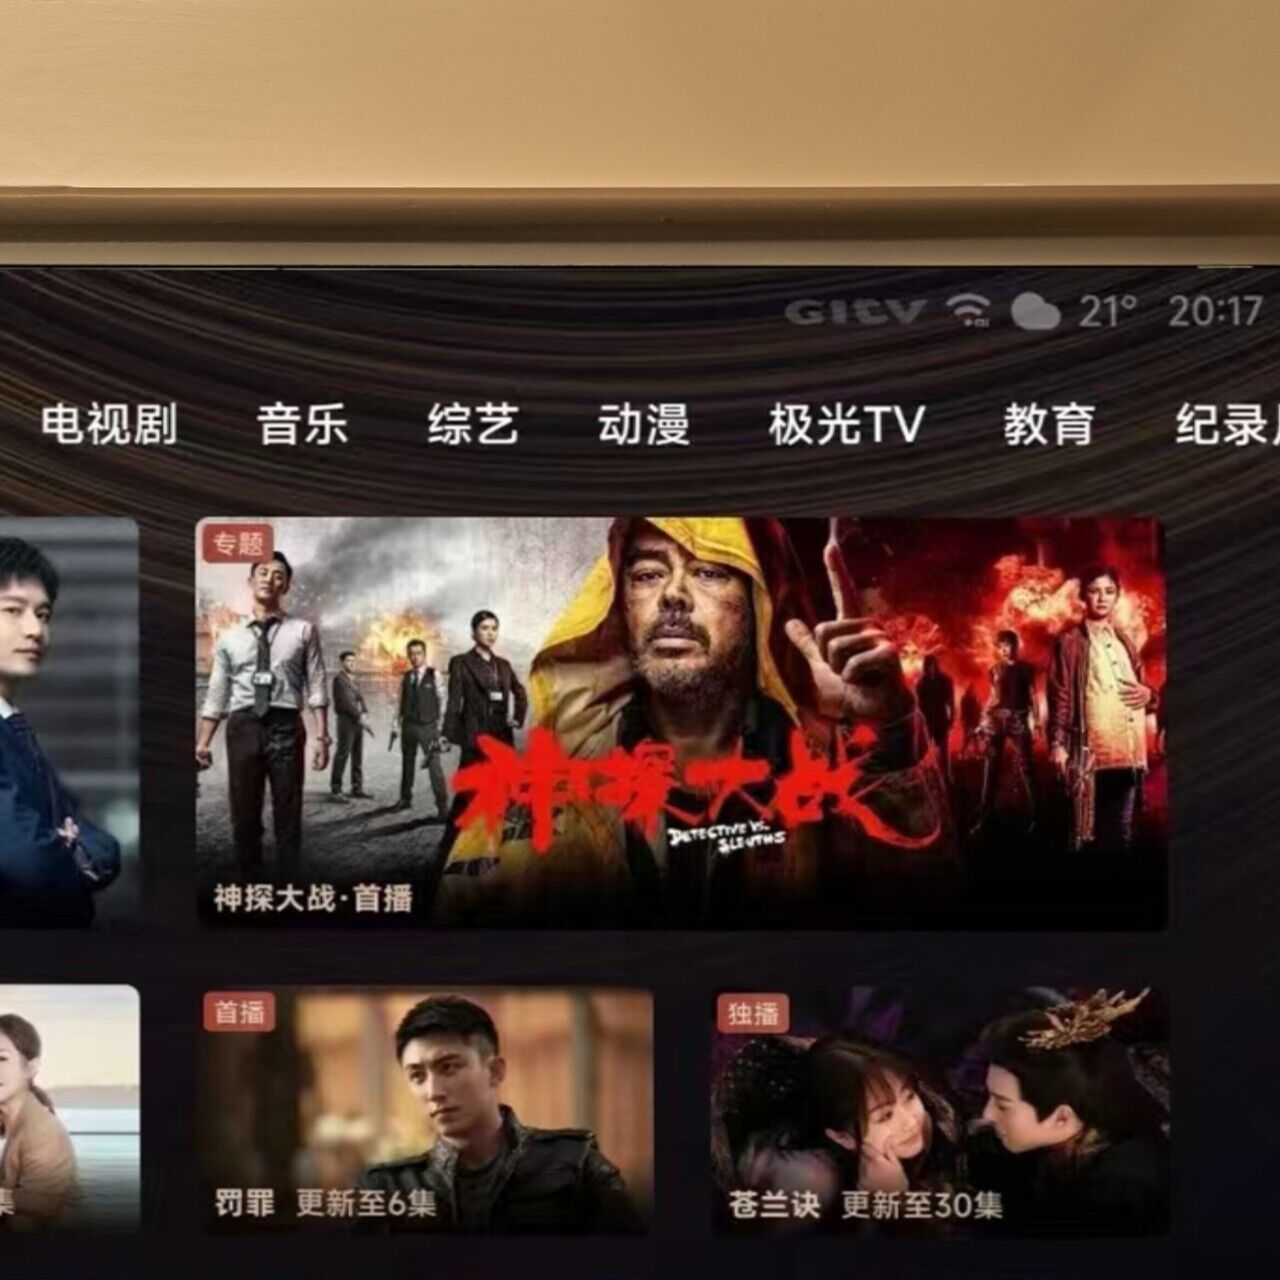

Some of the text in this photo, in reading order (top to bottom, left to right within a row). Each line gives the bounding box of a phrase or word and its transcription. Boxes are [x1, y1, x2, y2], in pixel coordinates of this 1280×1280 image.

[1169, 294, 1263, 327] 20:17
[42, 401, 177, 445] 电视剧
[257, 401, 348, 446] 音乐
[428, 401, 519, 445] 综艺
[598, 401, 690, 446] 动漫
[769, 402, 926, 446] 极光TV
[1004, 401, 1096, 446] 教育
[213, 531, 263, 556] 专题
[214, 883, 412, 913] 神探大战·首播
[215, 1000, 265, 1025] 首播
[728, 1001, 779, 1026] 独播
[215, 1187, 436, 1217] 罚罪 更新至6集
[729, 1189, 1003, 1219] 苍兰诀 更新至30集
